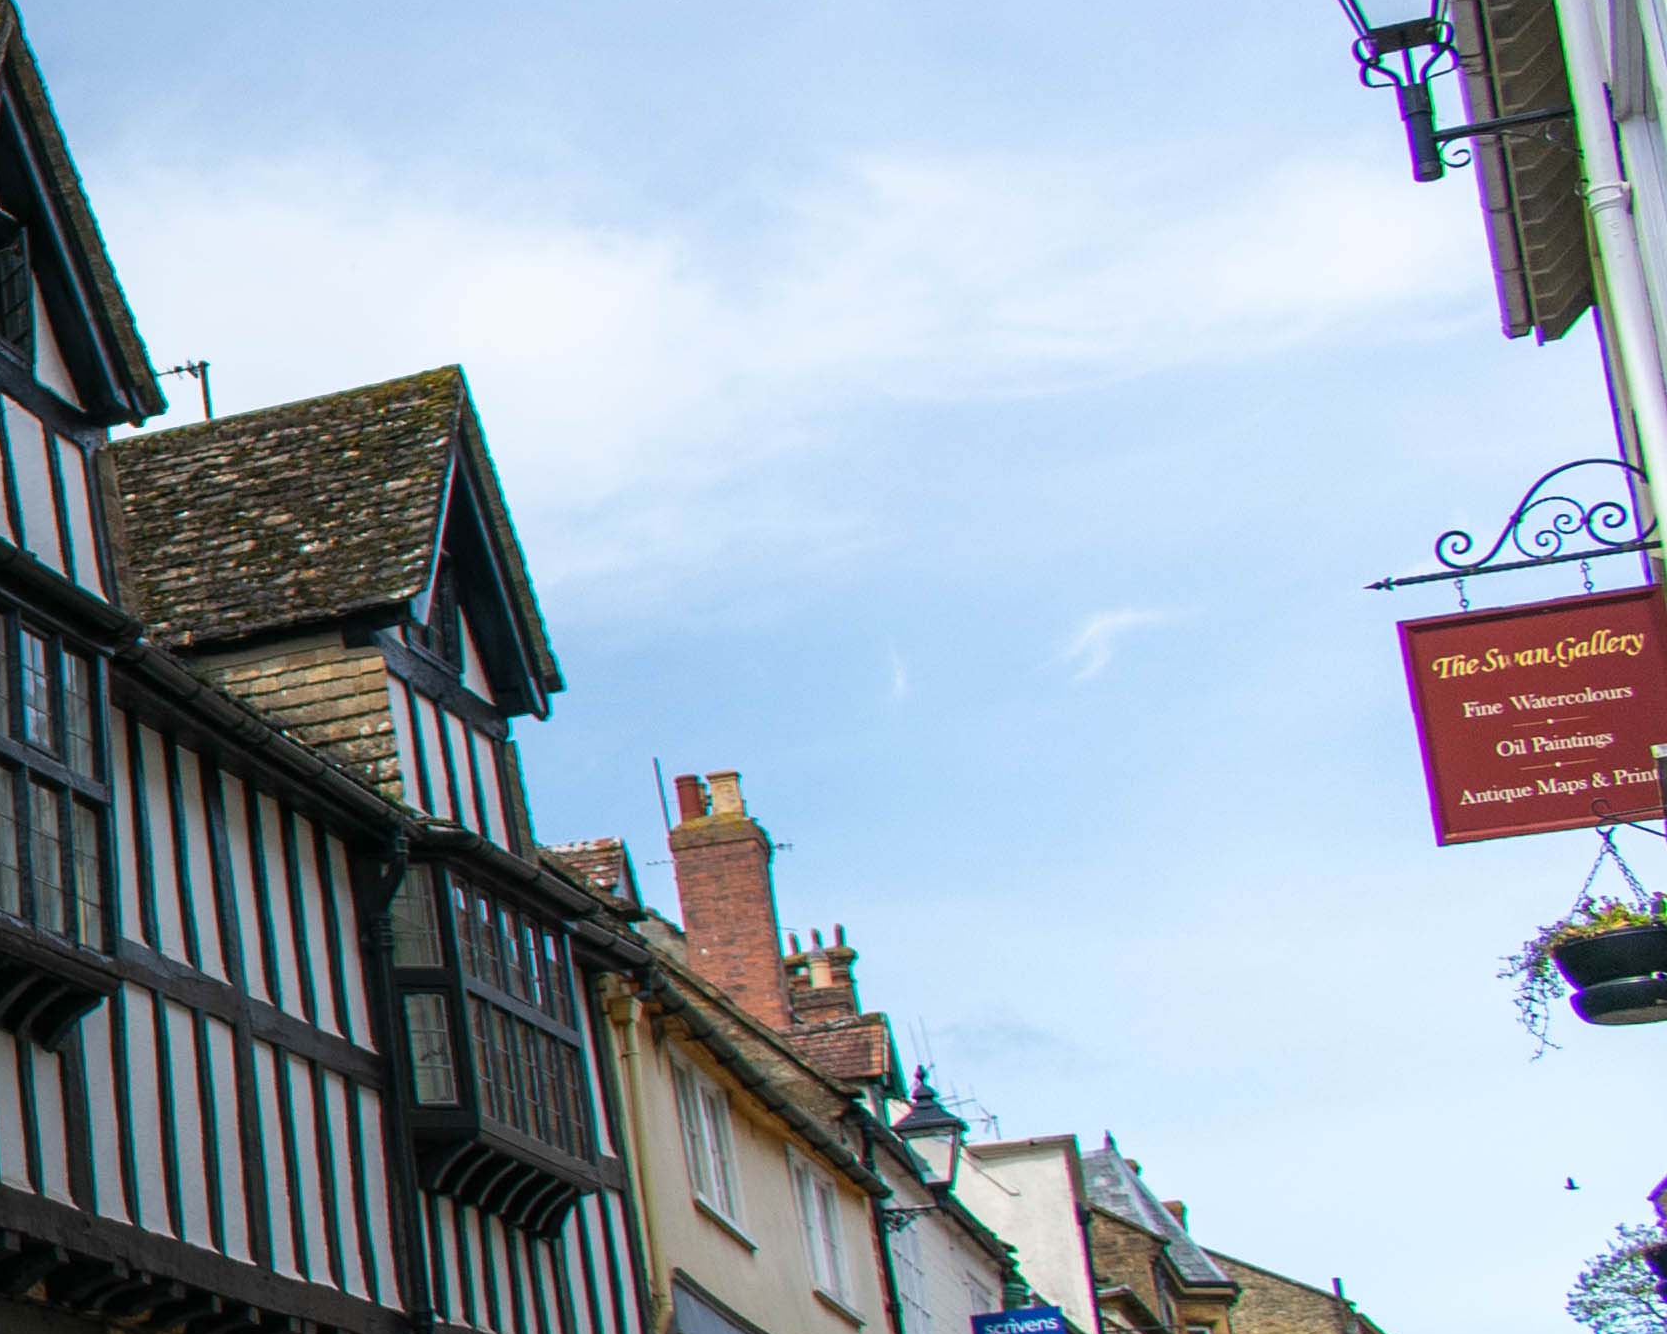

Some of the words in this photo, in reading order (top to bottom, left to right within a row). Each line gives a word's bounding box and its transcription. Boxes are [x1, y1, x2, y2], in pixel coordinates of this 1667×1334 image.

[1432, 655, 1479, 679] The
[1481, 648, 1555, 672] Swan
[1555, 630, 1644, 667] Gallery
[1462, 702, 1503, 718] Fine
[1509, 687, 1633, 711] Watercolours
[1496, 739, 1526, 757] Oil
[1531, 732, 1614, 754] Paintings
[1459, 785, 1533, 805] Antique
[1536, 776, 1587, 796] Maps
[1591, 771, 1611, 789] &
[1613, 768, 1659, 786] Print
